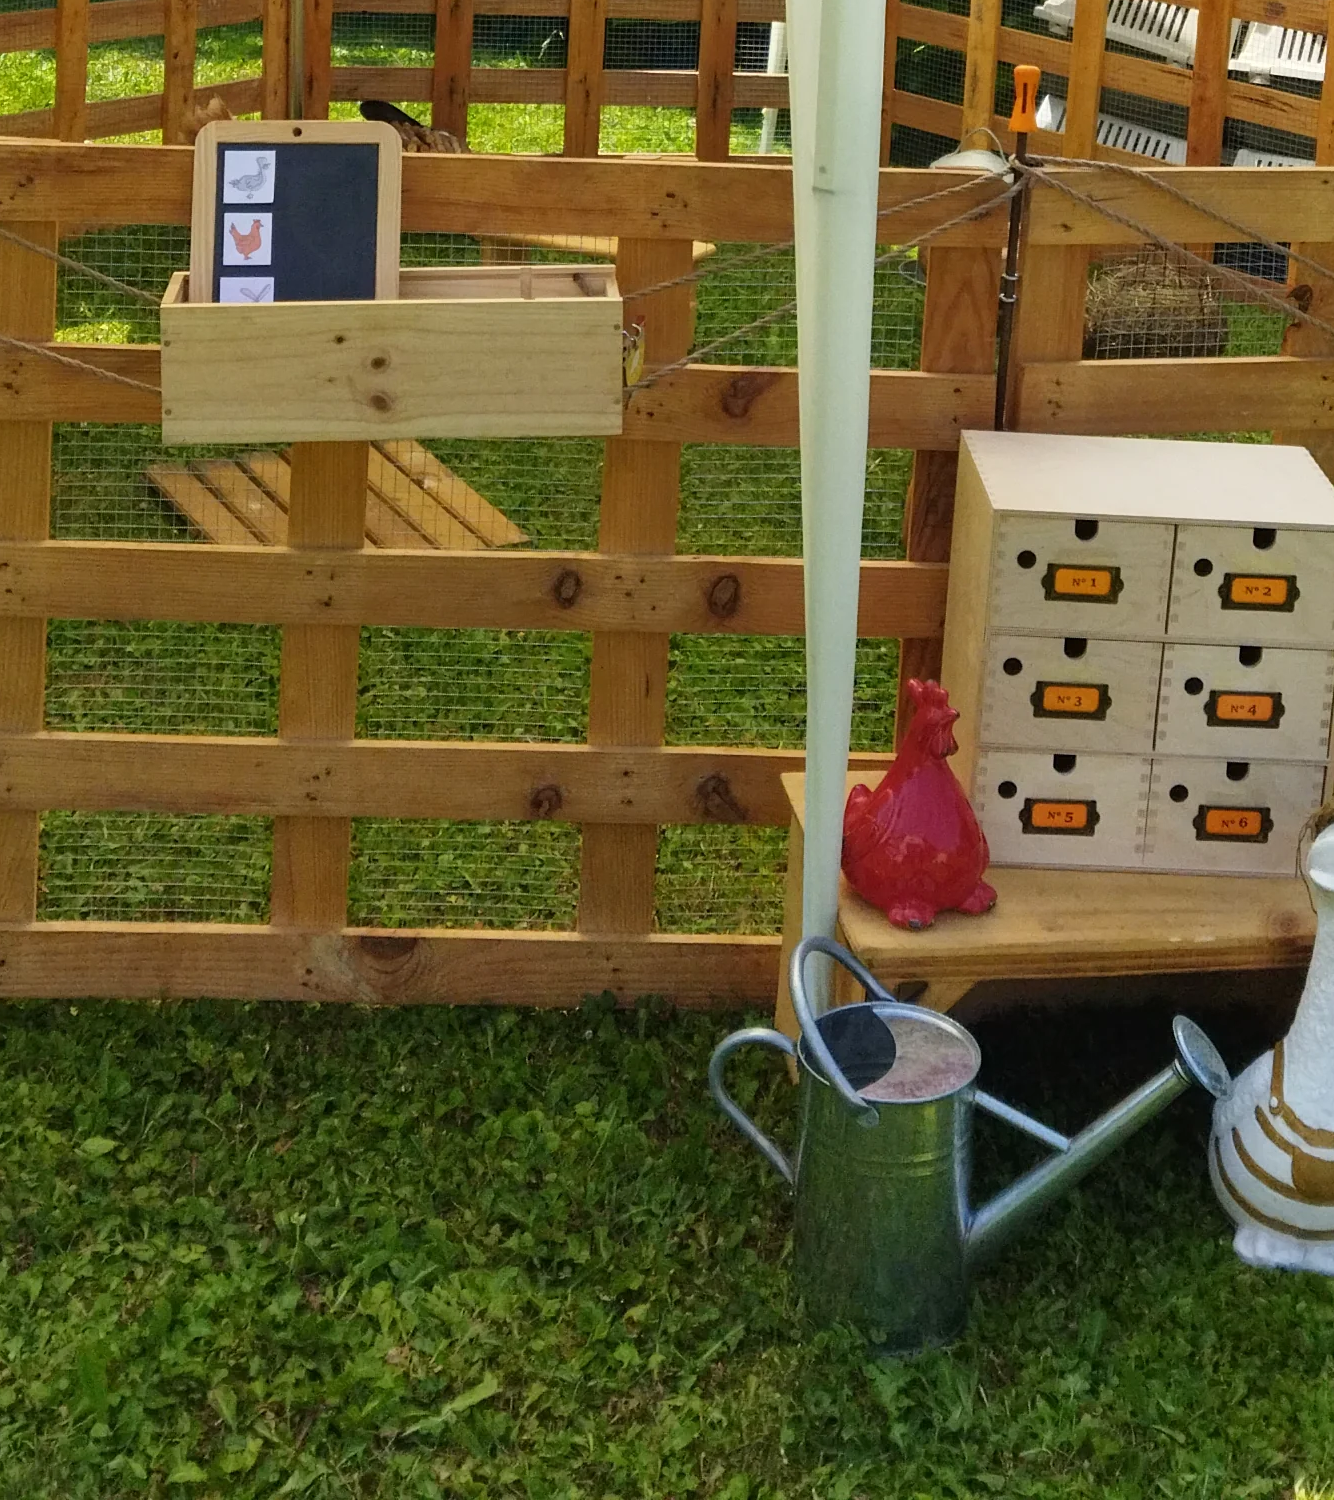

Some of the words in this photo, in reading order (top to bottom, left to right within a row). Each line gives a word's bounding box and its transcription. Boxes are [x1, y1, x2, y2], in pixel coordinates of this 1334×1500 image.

[1090, 577, 1097, 588] 1
[1262, 586, 1272, 597] 2
[1073, 695, 1083, 707] 3
[1247, 704, 1257, 716] 4
[1064, 811, 1074, 823] 5
[1238, 816, 1248, 828] 6
